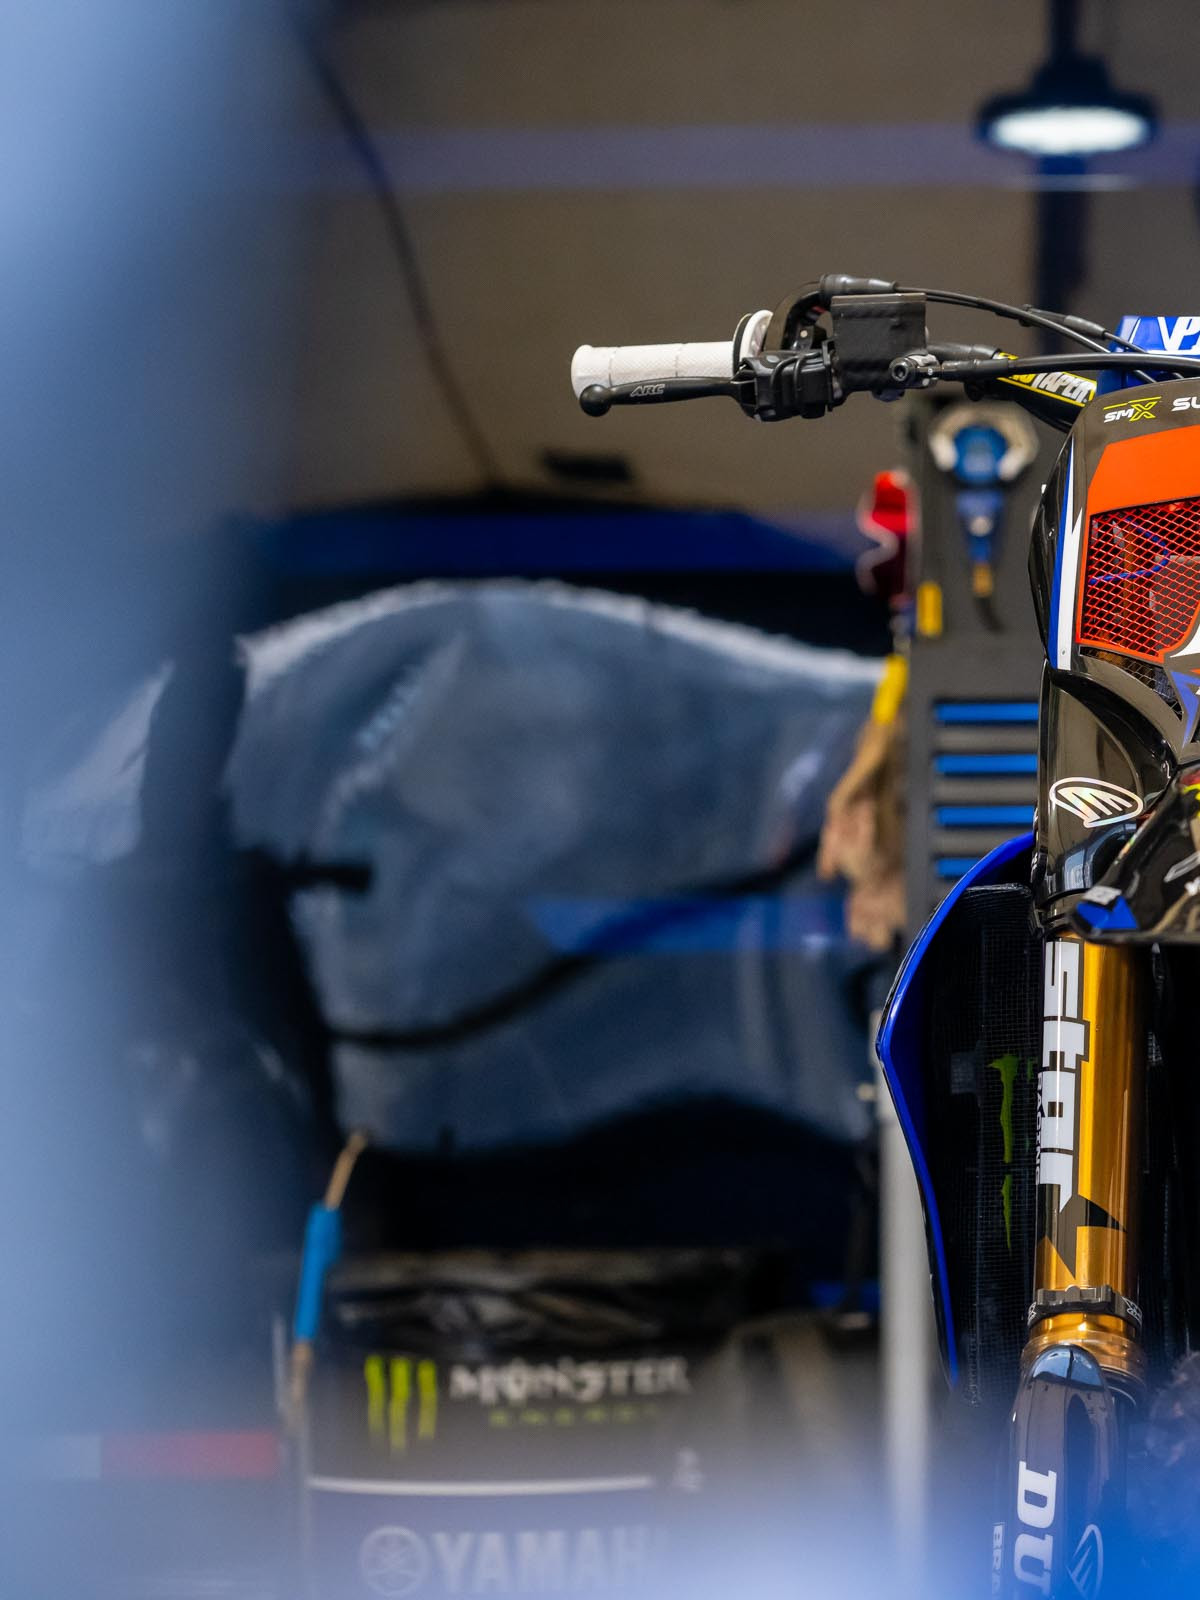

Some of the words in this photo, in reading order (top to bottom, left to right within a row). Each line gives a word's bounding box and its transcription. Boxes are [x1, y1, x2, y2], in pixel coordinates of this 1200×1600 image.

[630, 383, 666, 397] ARC
[1103, 401, 1157, 423] SMX
[433, 1528, 663, 1593] YAMAH
